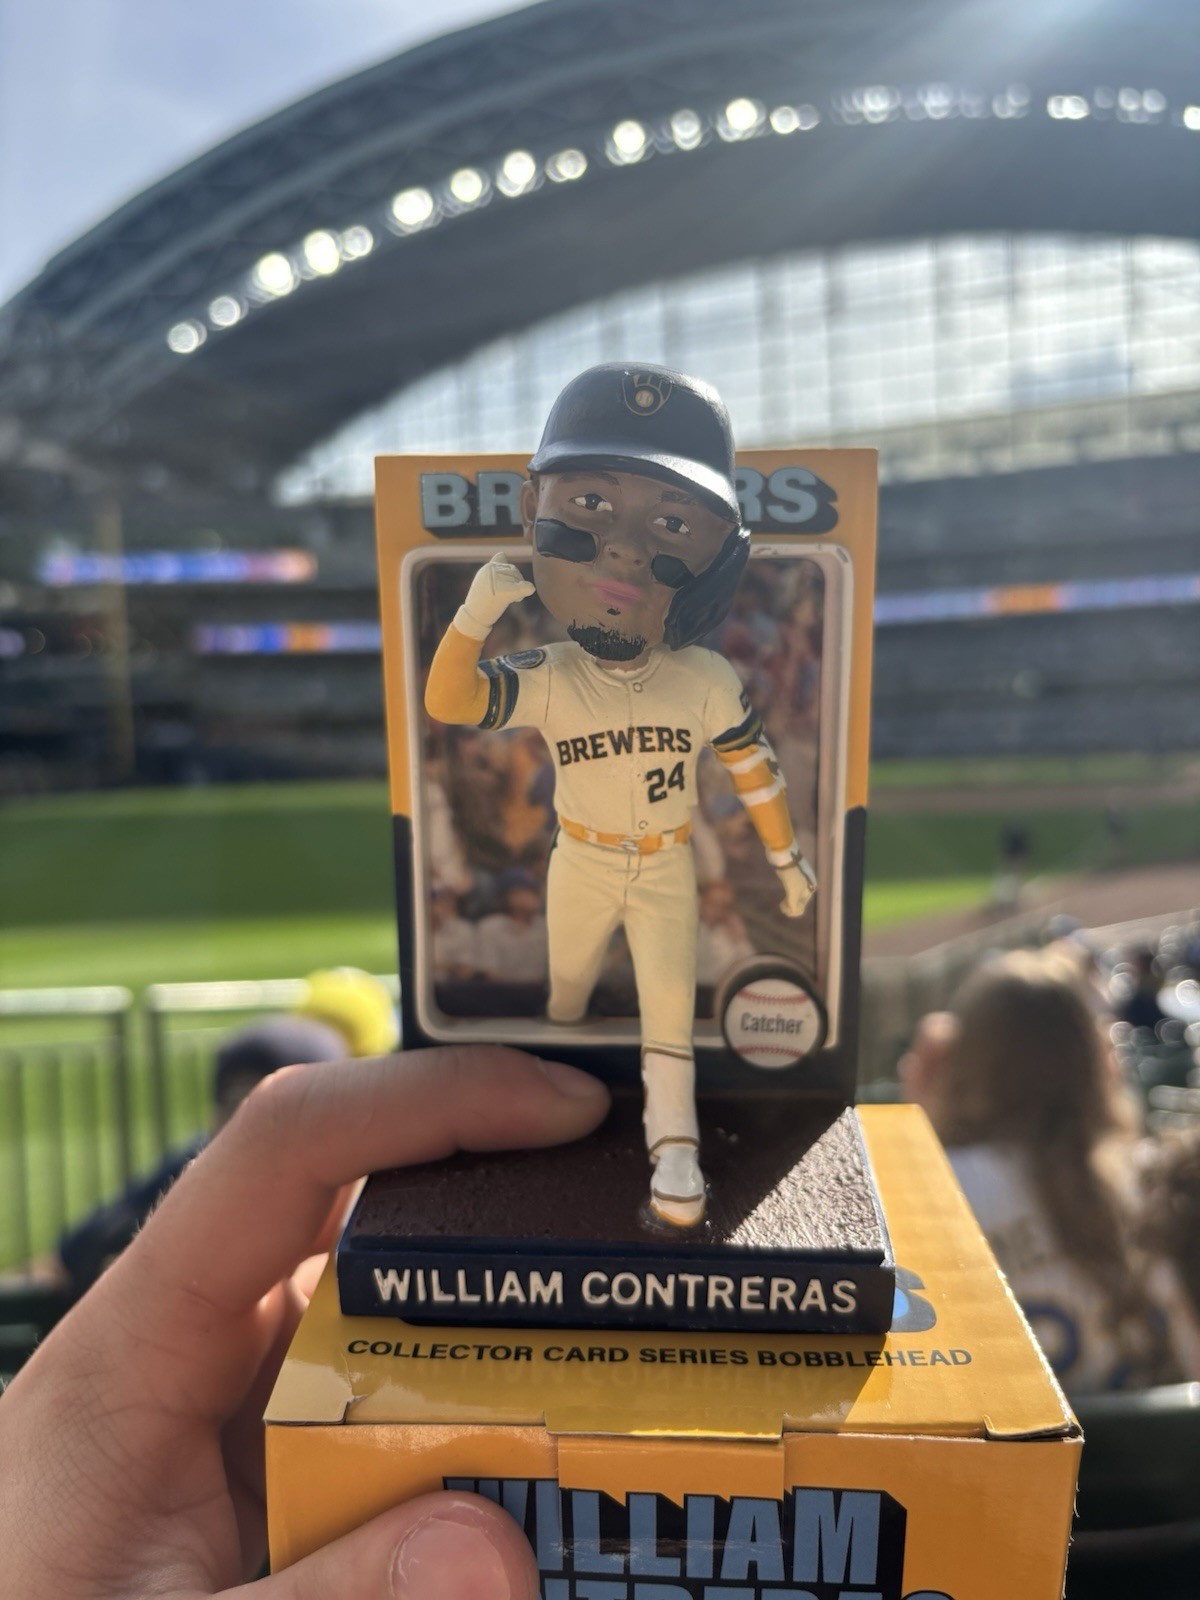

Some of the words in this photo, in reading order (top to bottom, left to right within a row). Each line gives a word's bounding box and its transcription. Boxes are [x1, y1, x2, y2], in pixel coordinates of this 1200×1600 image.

[420, 465, 832, 536] BRRS
[556, 725, 692, 767] BREWERS
[645, 760, 685, 805] 24
[740, 1011, 805, 1035] Catcher
[373, 1267, 564, 1306] WILLIAM
[581, 1270, 858, 1314] CONTRERAS
[347, 1339, 533, 1362] COLLECTOR
[543, 1346, 629, 1363] CARD
[639, 1347, 749, 1366] SERIES
[757, 1349, 973, 1368] BOBBLEHEAD
